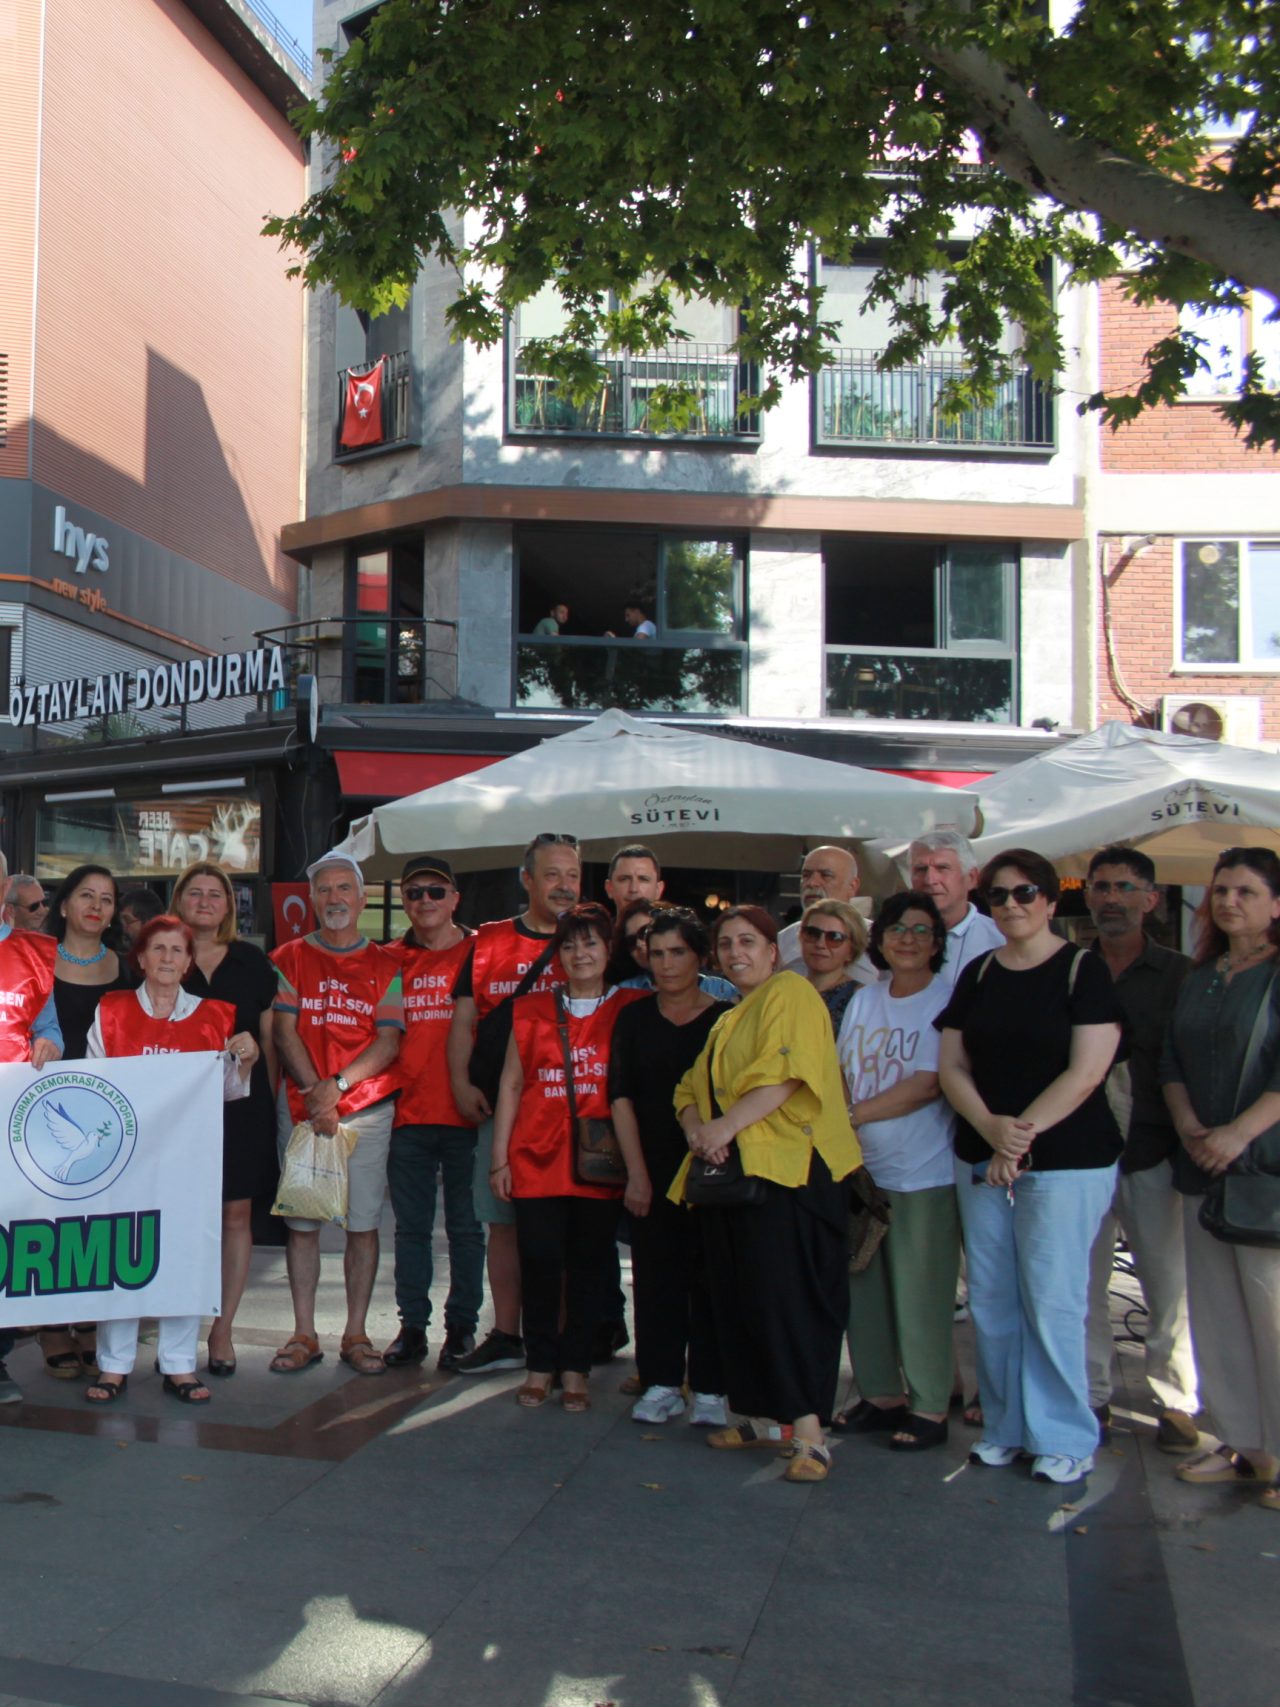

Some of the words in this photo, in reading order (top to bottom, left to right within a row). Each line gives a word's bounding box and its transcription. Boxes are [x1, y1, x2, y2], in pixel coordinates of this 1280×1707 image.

[54, 505, 110, 573] hys
[52, 578, 78, 600] new
[80, 587, 108, 613] style
[9, 671, 127, 727] ÖZTAYLAN
[135, 646, 285, 710] DONDURMA
[631, 808, 719, 825] SÜTEVİ
[1151, 803, 1239, 821] SÜTEVİ
[413, 974, 448, 989] DİSK
[12, 1091, 37, 1143] BANDIRMA
[35, 1075, 97, 1095] DEMOKRASİ
[96, 1082, 135, 1137] PLATFORMU
